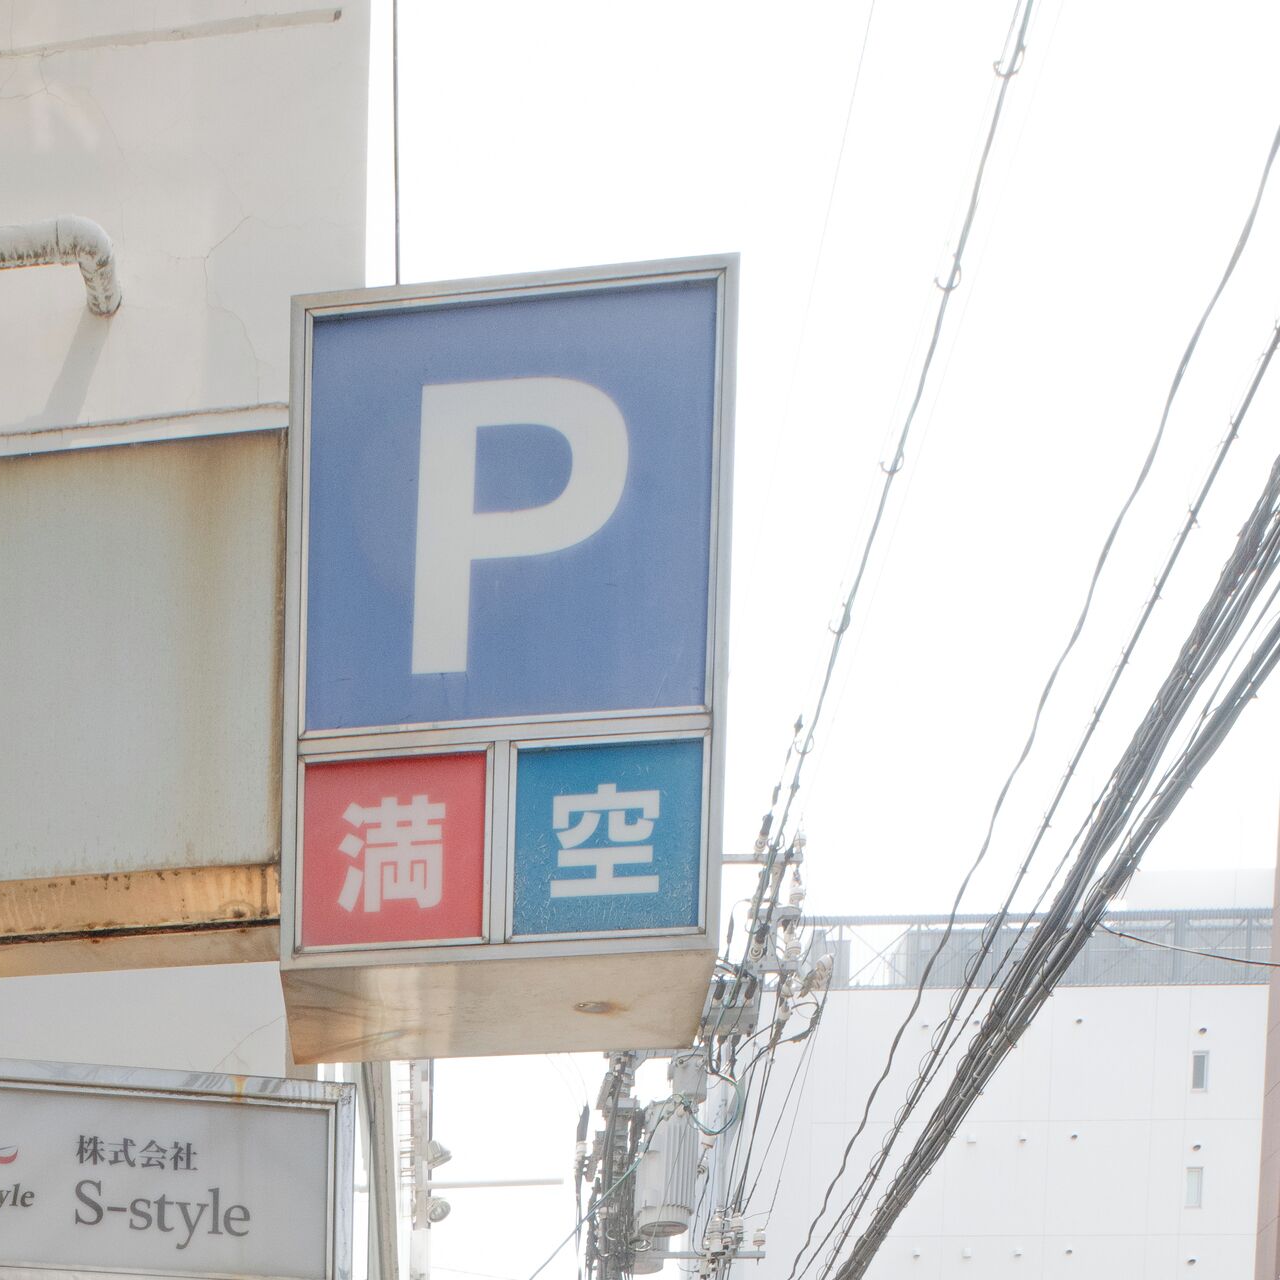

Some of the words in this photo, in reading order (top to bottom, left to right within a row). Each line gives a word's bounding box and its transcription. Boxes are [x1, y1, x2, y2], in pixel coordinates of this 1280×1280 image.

[411, 376, 630, 675] P
[336, 793, 447, 914] 満
[549, 783, 660, 899] 空
[76, 1135, 198, 1172] 株式会社
[74, 1179, 252, 1250] S-style
